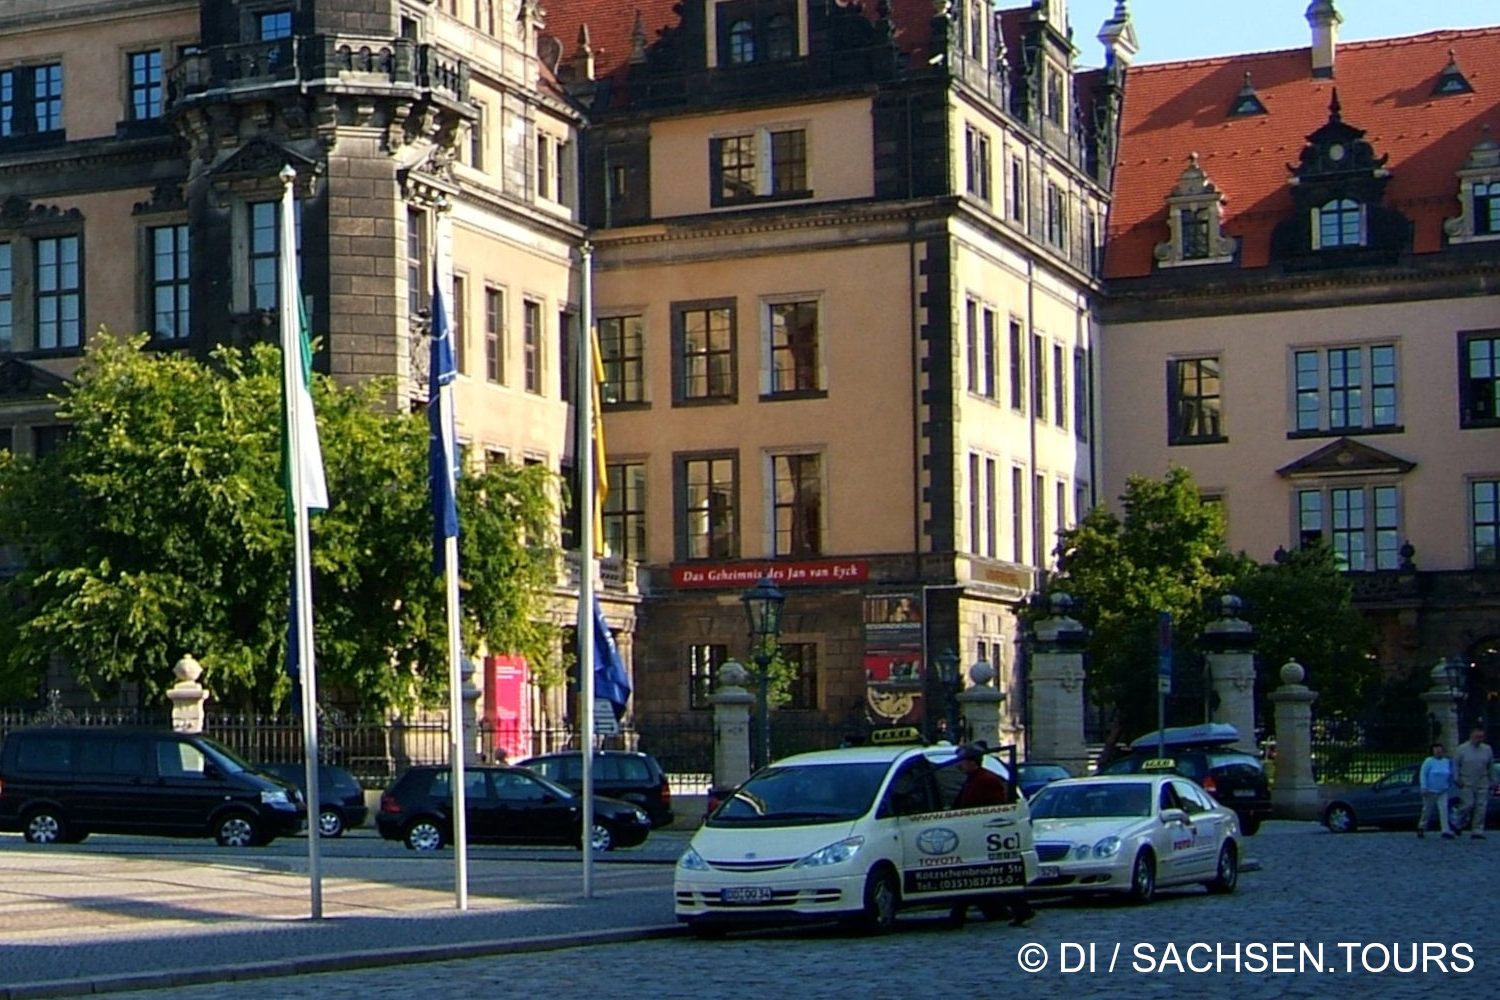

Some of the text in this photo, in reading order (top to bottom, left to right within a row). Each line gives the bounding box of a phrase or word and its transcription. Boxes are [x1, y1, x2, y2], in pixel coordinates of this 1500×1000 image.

[682, 564, 858, 582] Das Geheimnis des Jan van Eyck
[919, 855, 963, 867] TOYOTA
[915, 867, 1004, 879] Kötzschenbroder
